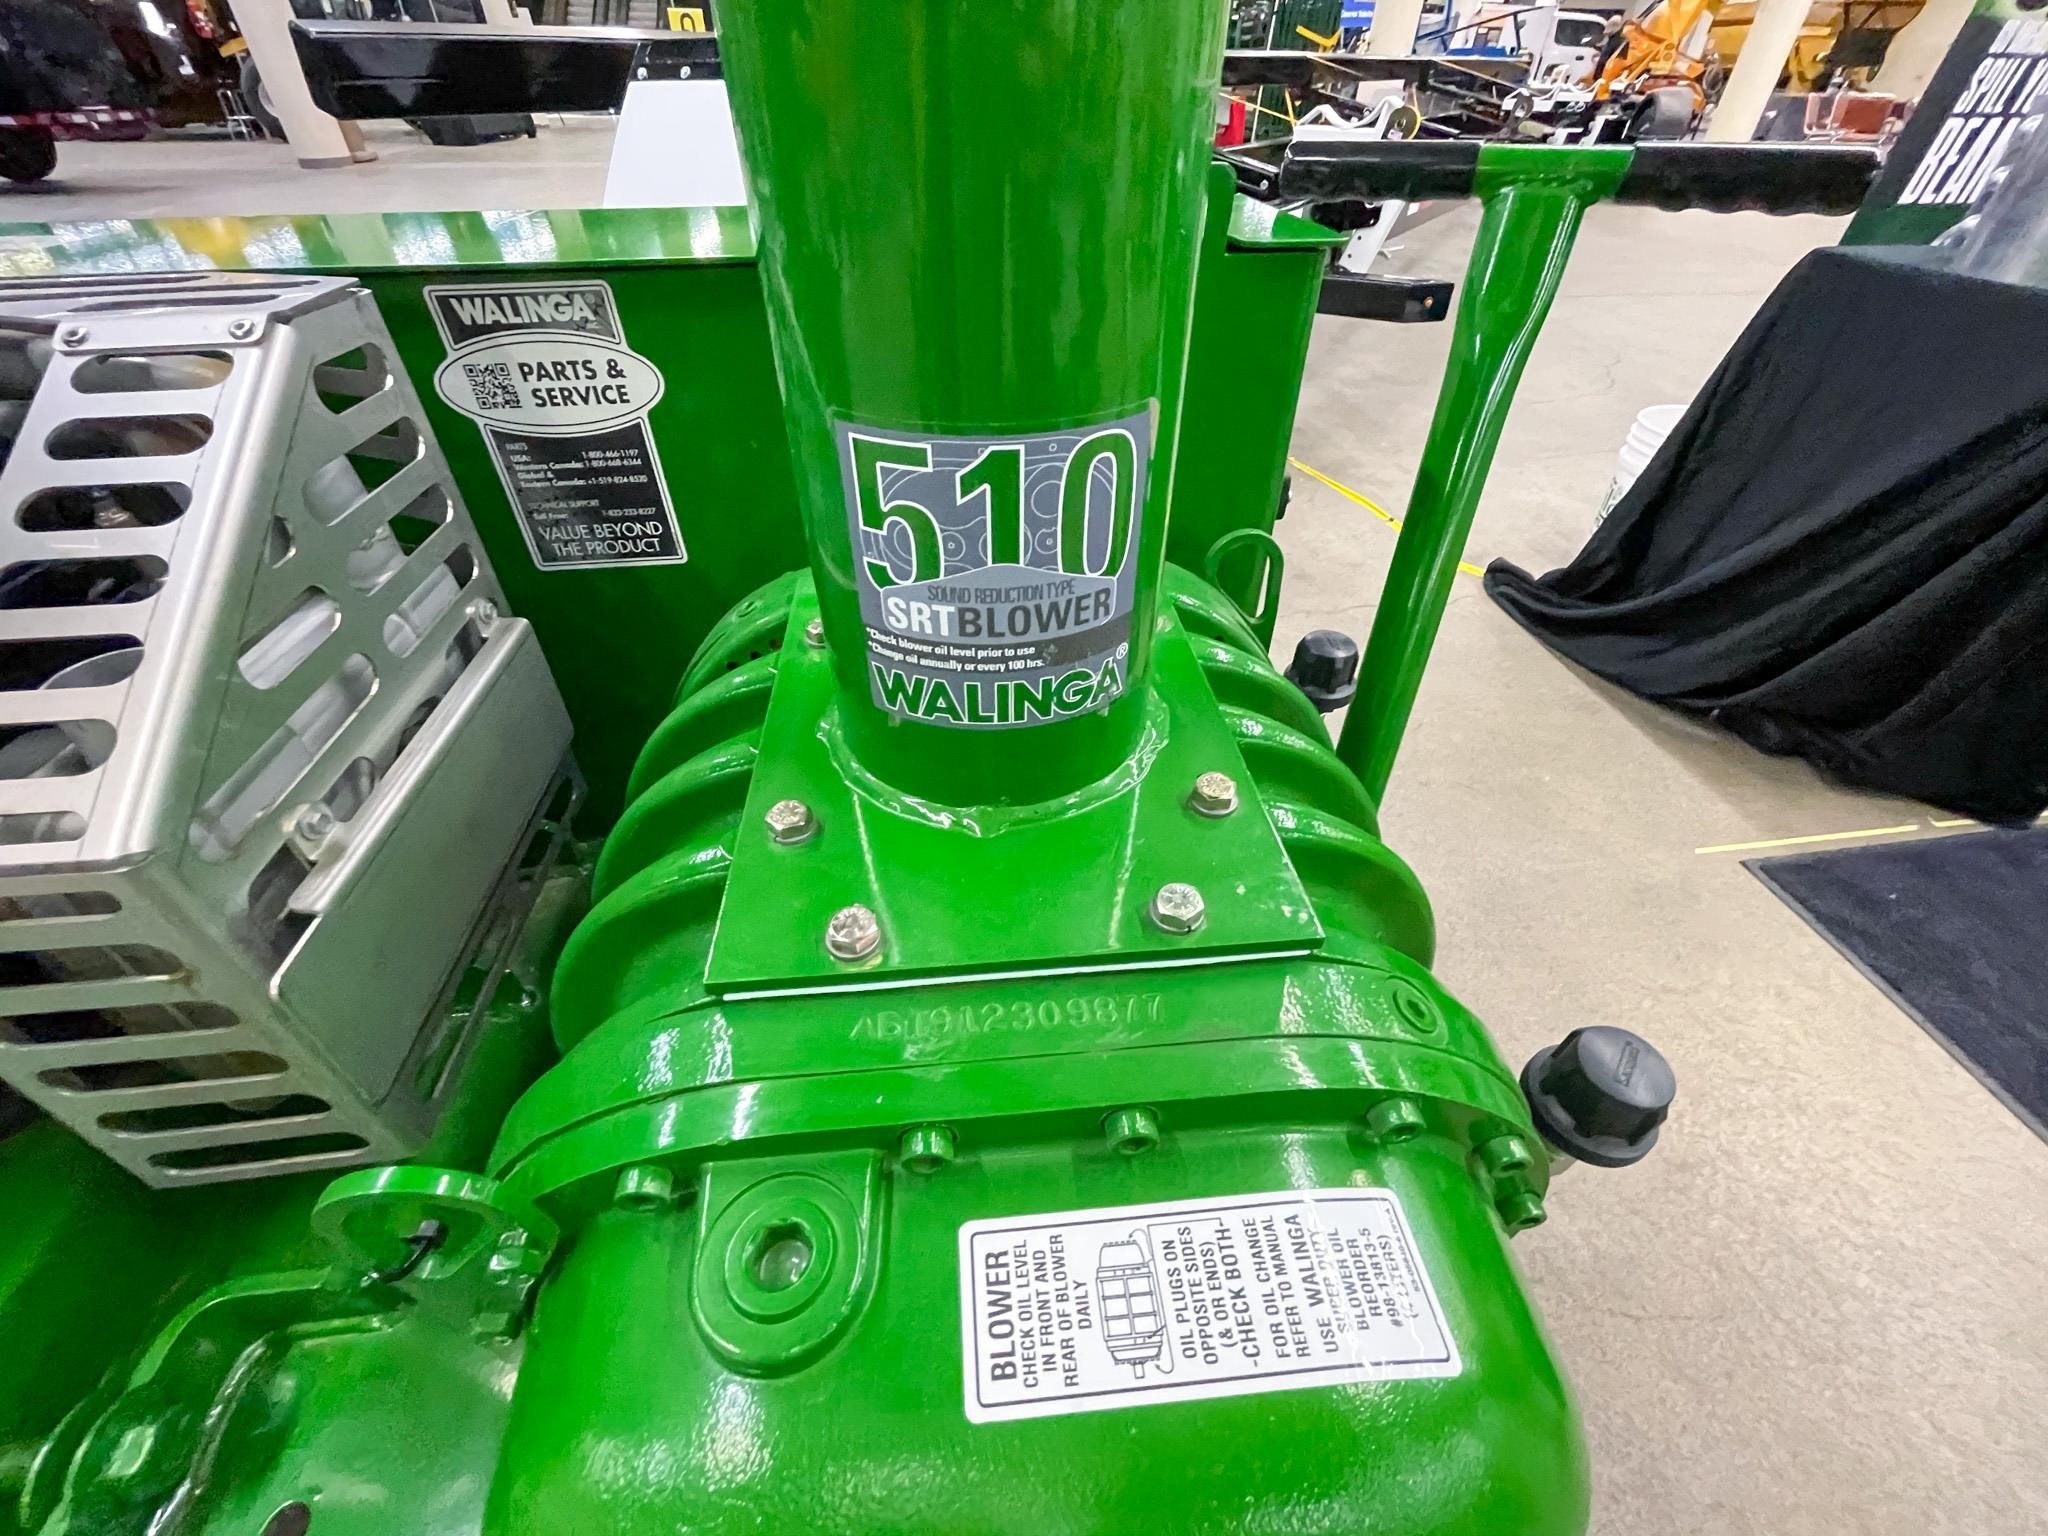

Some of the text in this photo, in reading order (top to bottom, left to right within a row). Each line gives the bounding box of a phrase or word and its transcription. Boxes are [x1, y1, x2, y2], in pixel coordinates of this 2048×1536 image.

[1951, 56, 2032, 114] SPILL
[449, 293, 596, 325] WALINGA
[517, 358, 627, 382] PARTS &
[531, 384, 630, 407] SERVICE
[538, 521, 663, 541] VALUE BEYOND
[551, 537, 661, 558] THE PRODUCT
[849, 428, 1137, 591] 510
[927, 578, 1076, 604] SOUND REDUCTION TYPE
[898, 637, 932, 653] blower
[935, 645, 948, 655] oil
[950, 646, 976, 658] level
[977, 647, 1001, 660] prior
[1004, 647, 1014, 657] to
[1016, 646, 1035, 656] use
[905, 654, 918, 664] oil
[920, 657, 962, 672] annually
[963, 663, 975, 671] or
[977, 662, 1006, 672] every
[1007, 659, 1025, 670] 100
[985, 1250, 1017, 1381] BLOWER
[1014, 1239, 1039, 1388] CHECK OIL LEVEL
[1033, 1250, 1057, 1372] IN FRONT AND
[1050, 1233, 1079, 1387] REAR OF BLOWER
[1073, 1280, 1092, 1330] DAILY
[1162, 1240, 1197, 1359] OIL PLUGS ON
[1178, 1226, 1218, 1364] OPPOSITE SIDES
[1199, 1241, 1239, 1348] (& OR ENDS)
[1242, 1217, 1291, 1359] FOR OIL CHANGE
[1261, 1215, 1311, 1358] REFER TO MANUAL
[1284, 1214, 1339, 1353] USE WALINGA
[1326, 1227, 1370, 1331] BLOWER OIL
[1346, 1238, 1383, 1317] REORDER
[1358, 1227, 1403, 1327] #98-13813-5
